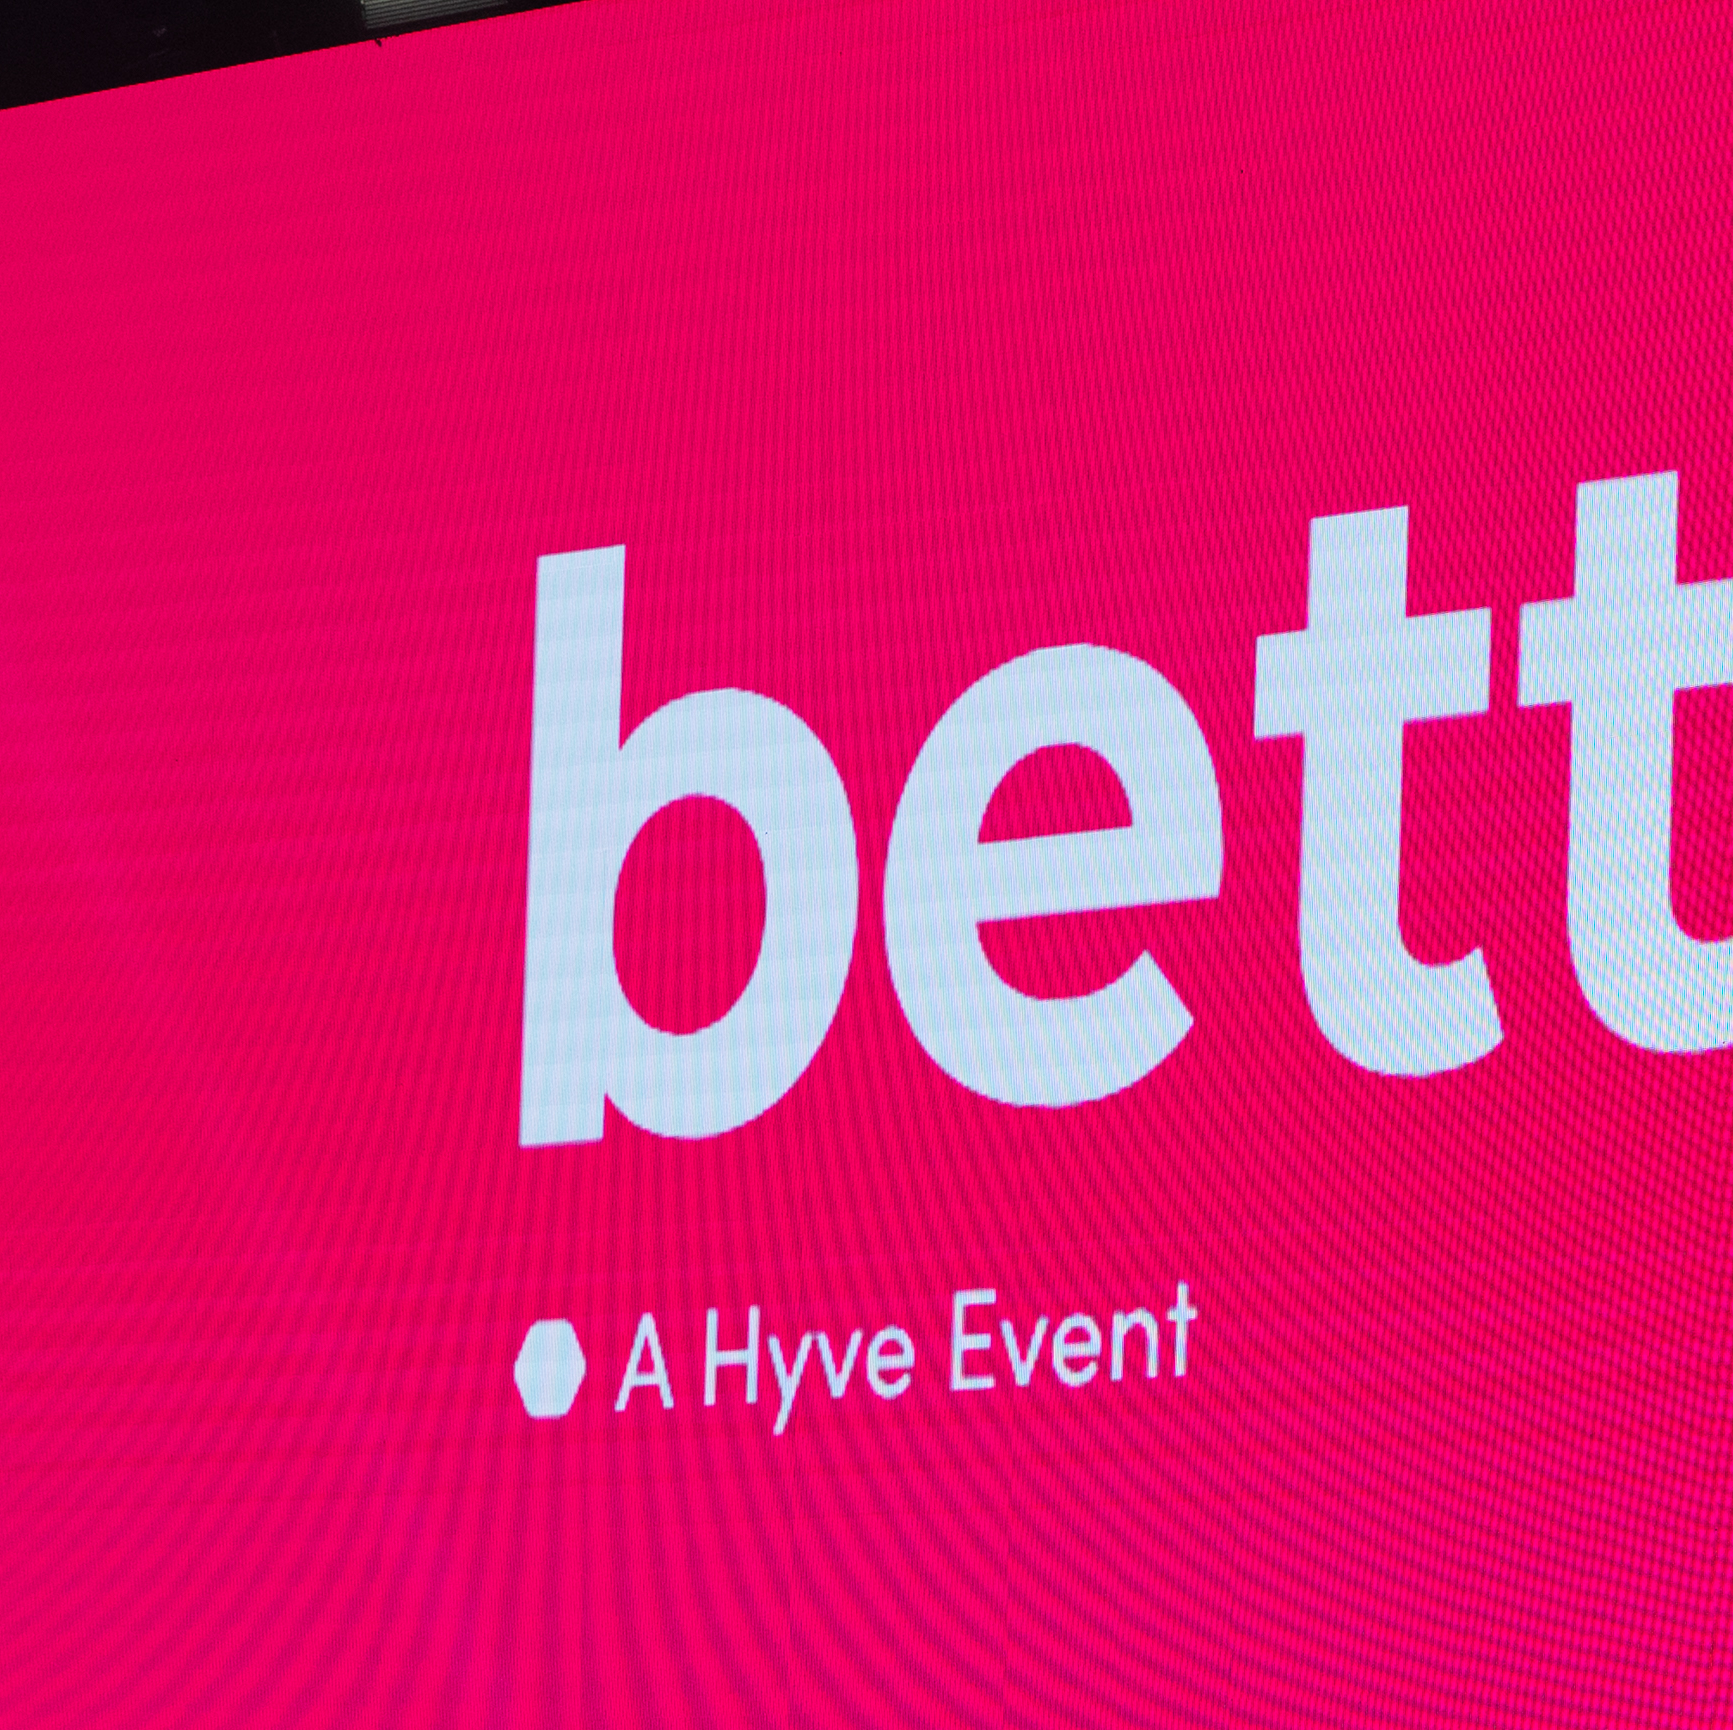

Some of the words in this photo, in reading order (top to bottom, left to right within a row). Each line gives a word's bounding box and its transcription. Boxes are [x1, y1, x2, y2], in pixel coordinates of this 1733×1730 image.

[614, 1312, 674, 1412] A
[703, 1304, 916, 1436] Hyve
[949, 1279, 1198, 1391] Event
